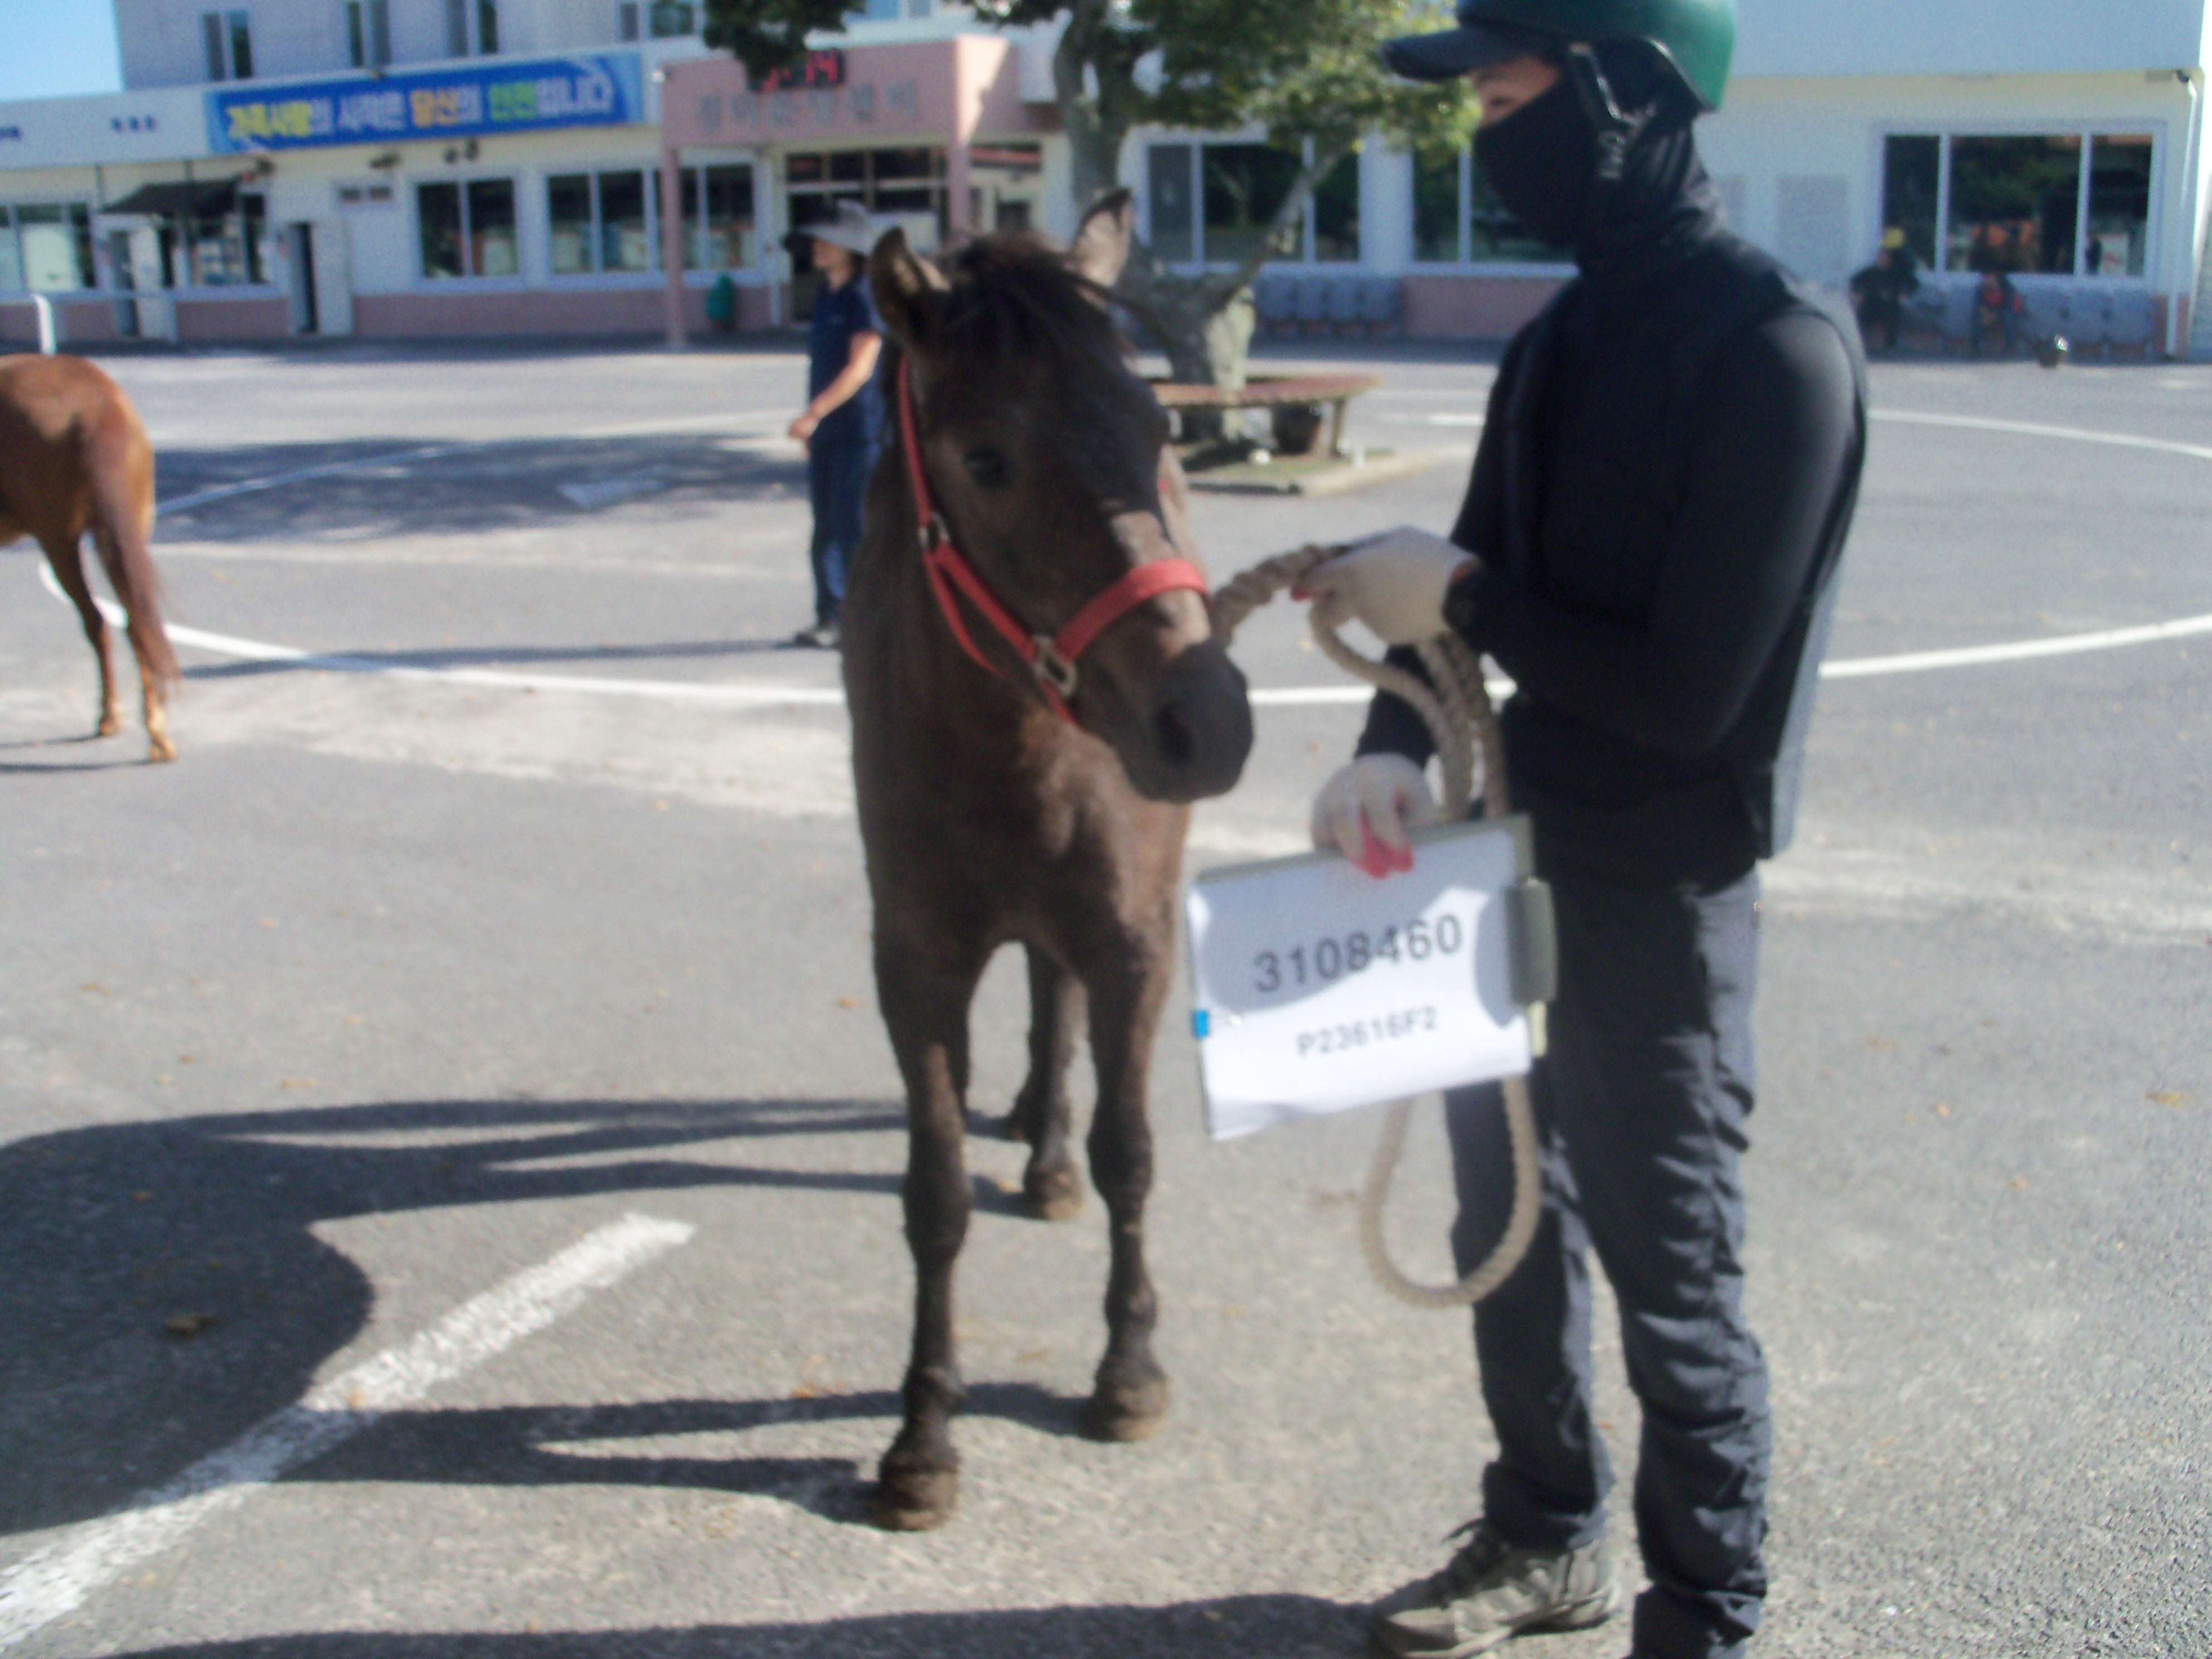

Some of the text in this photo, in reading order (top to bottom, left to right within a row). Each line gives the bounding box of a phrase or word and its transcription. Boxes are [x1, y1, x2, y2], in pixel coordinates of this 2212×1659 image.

[410, 85, 481, 127] 당신의
[489, 76, 612, 121] 안전입니다
[1254, 915, 1461, 992] 3108460
[1297, 1006, 1437, 1058] P23616F2
